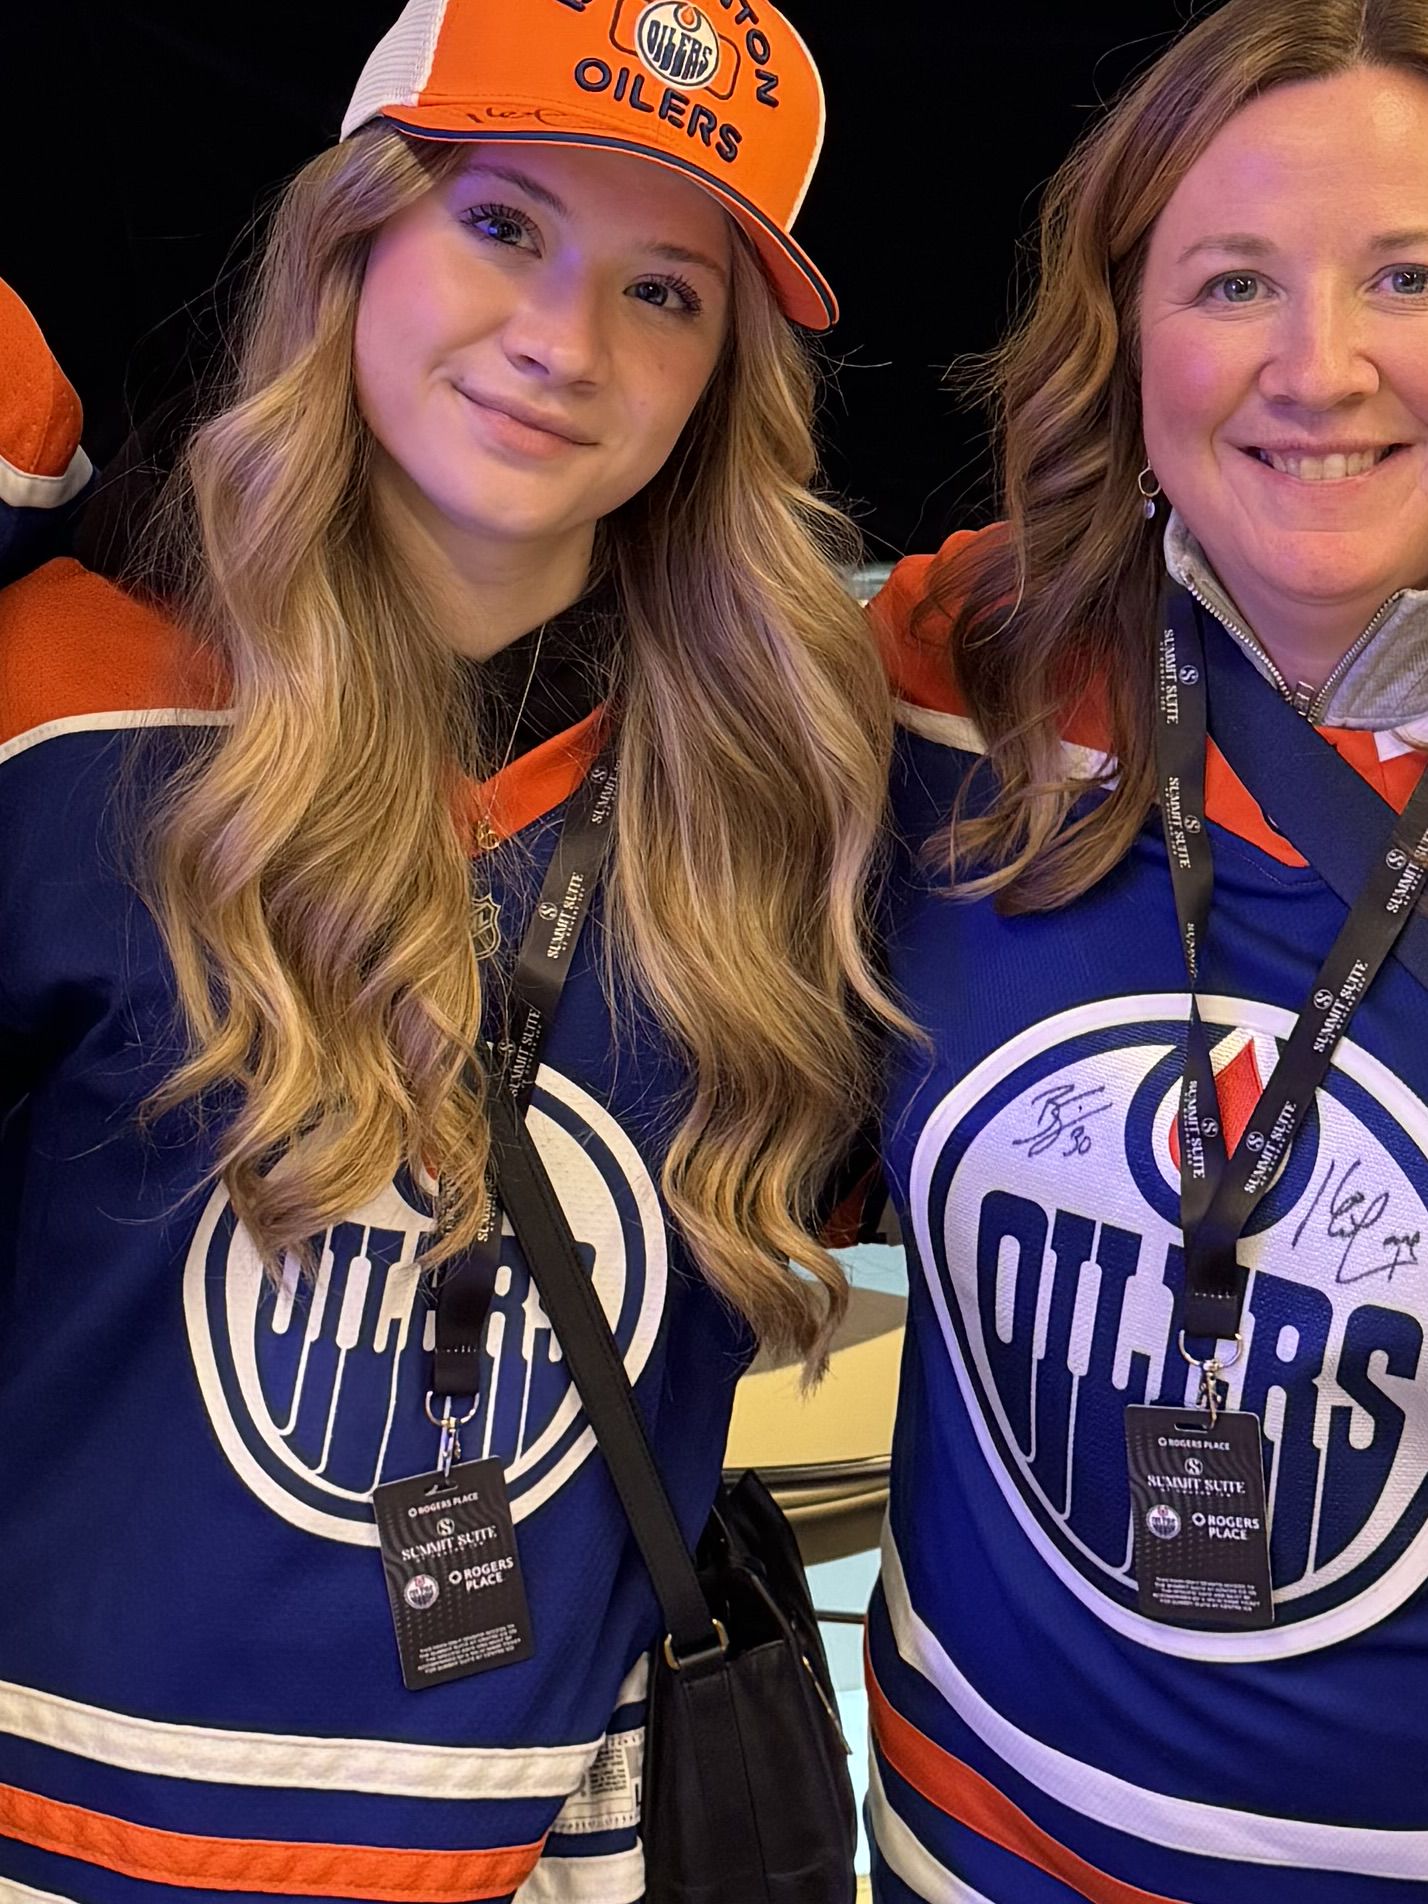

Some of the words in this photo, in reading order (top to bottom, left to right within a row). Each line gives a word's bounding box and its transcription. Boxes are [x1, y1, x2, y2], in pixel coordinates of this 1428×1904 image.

[646, 19, 713, 81] OILERS
[573, 57, 743, 164] OILERS
[1163, 628, 1177, 682] SUMMIT
[1165, 685, 1179, 725] SUITE
[1169, 777, 1184, 827] SUMMIT
[1173, 828, 1191, 869] SUITE
[1385, 860, 1420, 914] SUMMIT
[547, 910, 574, 959] SUMMIT
[563, 872, 584, 910] SUITE
[522, 1008, 541, 1044] SUITE
[1313, 1000, 1347, 1053] SUMMIT
[1340, 959, 1369, 1000] SUITE
[1188, 1080, 1201, 1135] SUMMIT
[1191, 1136, 1206, 1179] SUITE
[1244, 1140, 1277, 1194] SUMMIT
[1269, 1101, 1297, 1141] SUITE
[1168, 1438, 1203, 1450] ROGERS
[1203, 1440, 1230, 1451] PLACE
[417, 1500, 452, 1515] ROGERS
[452, 1492, 479, 1506] PLACE
[1147, 1474, 1202, 1491] SUMMIT
[1205, 1478, 1246, 1494] SUITE
[1207, 1514, 1260, 1530] ROGERS
[1208, 1526, 1248, 1540] PLACE
[400, 1536, 454, 1561] SUMMIT
[457, 1525, 498, 1546] SUITE
[462, 1556, 514, 1580] ROGERS
[465, 1572, 504, 1593] PLACE
